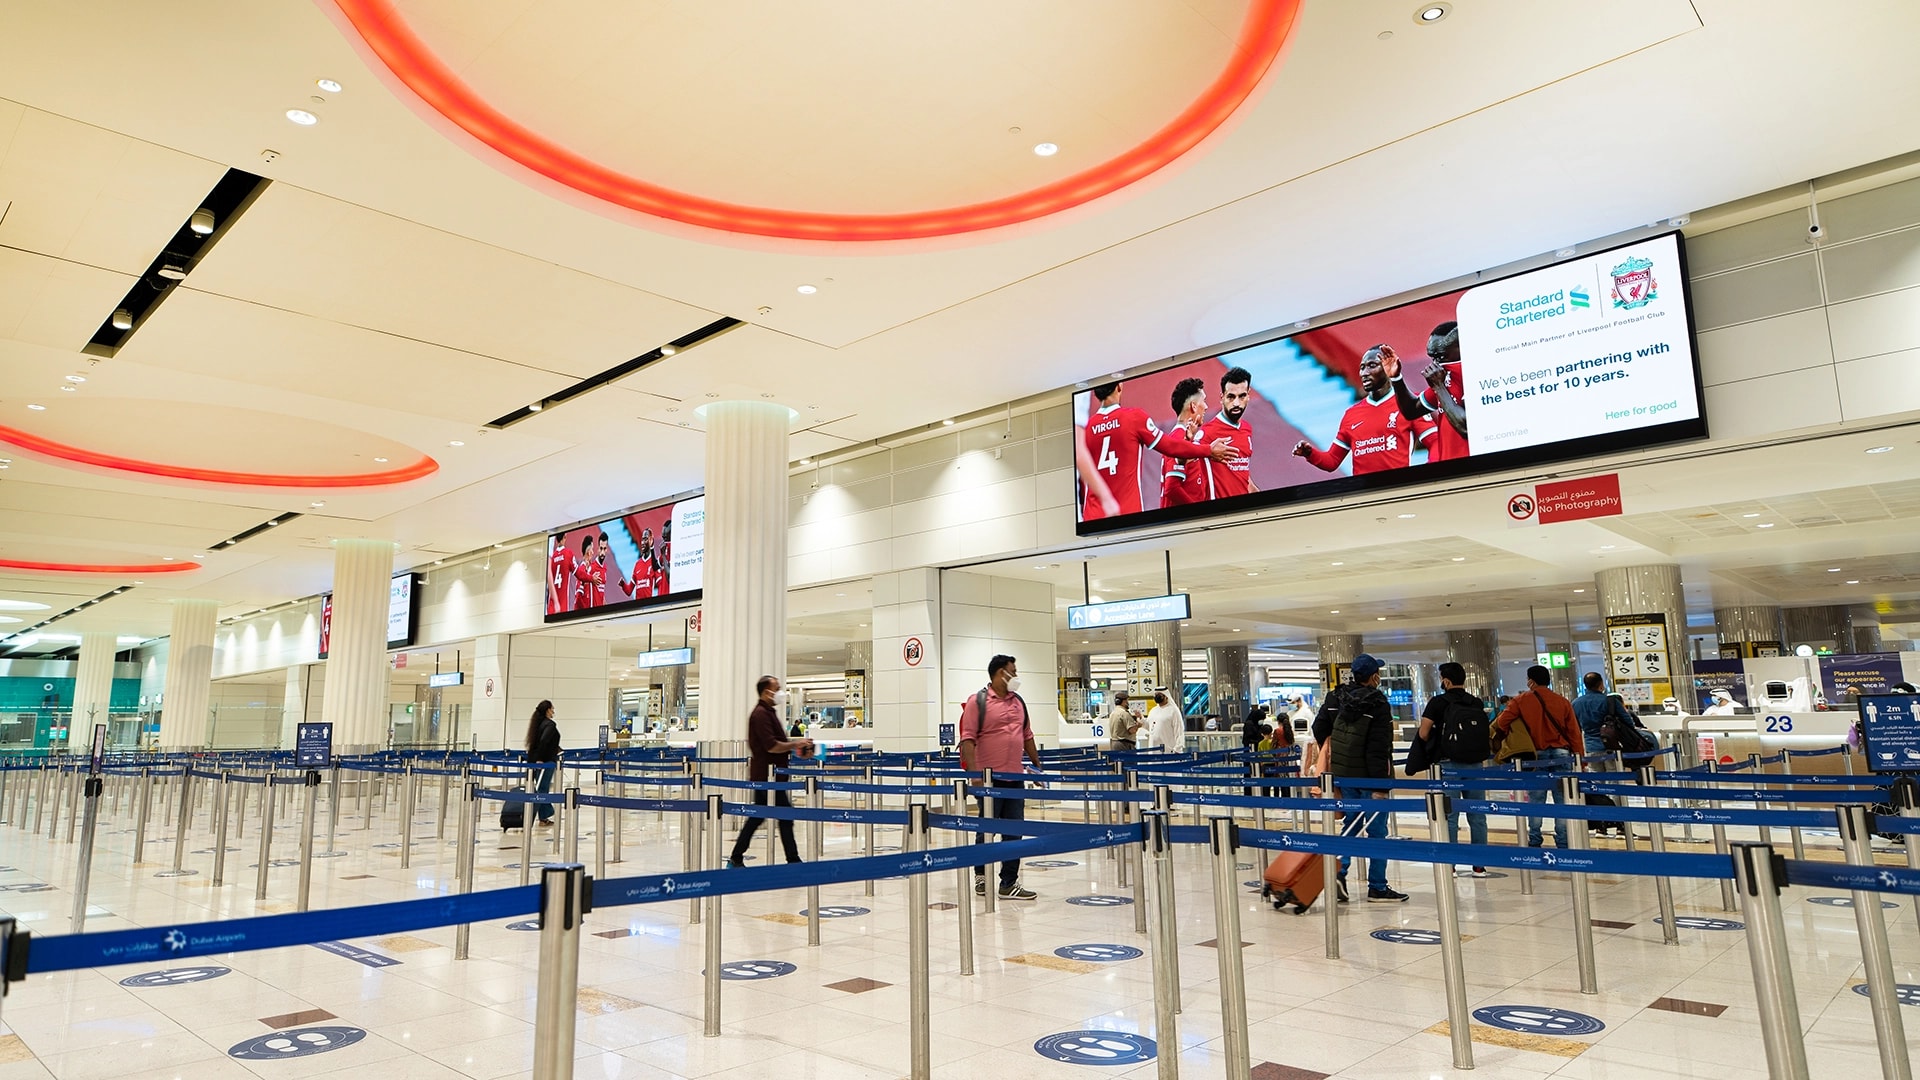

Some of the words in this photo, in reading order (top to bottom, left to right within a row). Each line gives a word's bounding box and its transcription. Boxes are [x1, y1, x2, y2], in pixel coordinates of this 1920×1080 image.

[1617, 272, 1649, 285] LIVERPOOL
[1500, 289, 1564, 315] Standard
[1496, 304, 1566, 329] Chartered
[1495, 343, 1520, 353] Official
[1521, 339, 1538, 348] Main
[1540, 333, 1566, 344] Partner
[1577, 323, 1611, 335] Liverpool
[1613, 315, 1645, 327] Football
[1647, 311, 1665, 320] Club
[1478, 375, 1517, 390] We've
[1520, 368, 1552, 382] been
[1556, 351, 1632, 377] partnering
[1636, 342, 1670, 358] with
[1481, 394, 1502, 406] the
[1506, 386, 1536, 401] best
[1539, 382, 1560, 394] for
[1563, 376, 1580, 389] 10
[1584, 369, 1629, 388] years.
[1605, 409, 1630, 420] Here
[1632, 406, 1647, 415] for
[1649, 400, 1678, 415] good
[1091, 418, 1121, 435] VIRGIL
[1355, 435, 1385, 448] Standard
[1484, 428, 1529, 441] sc.com/ae
[1097, 435, 1119, 476] 4
[1354, 444, 1386, 457] Chartered
[1538, 491, 1568, 505] التصوير
[1569, 489, 1596, 502] ممنوع
[1539, 505, 1553, 514] No
[1554, 496, 1620, 511] Photography
[553, 565, 563, 589] 4
[1103, 611, 1138, 622] Accessible
[1138, 611, 1155, 619] Lane
[1847, 676, 1887, 684] appearance.
[1886, 705, 1901, 713] 2m
[1091, 725, 1104, 737] 16
[1765, 715, 1793, 733] 23
[676, 882, 691, 890] Dubai
[190, 936, 214, 946] Dubai
[215, 933, 246, 943] Airports
